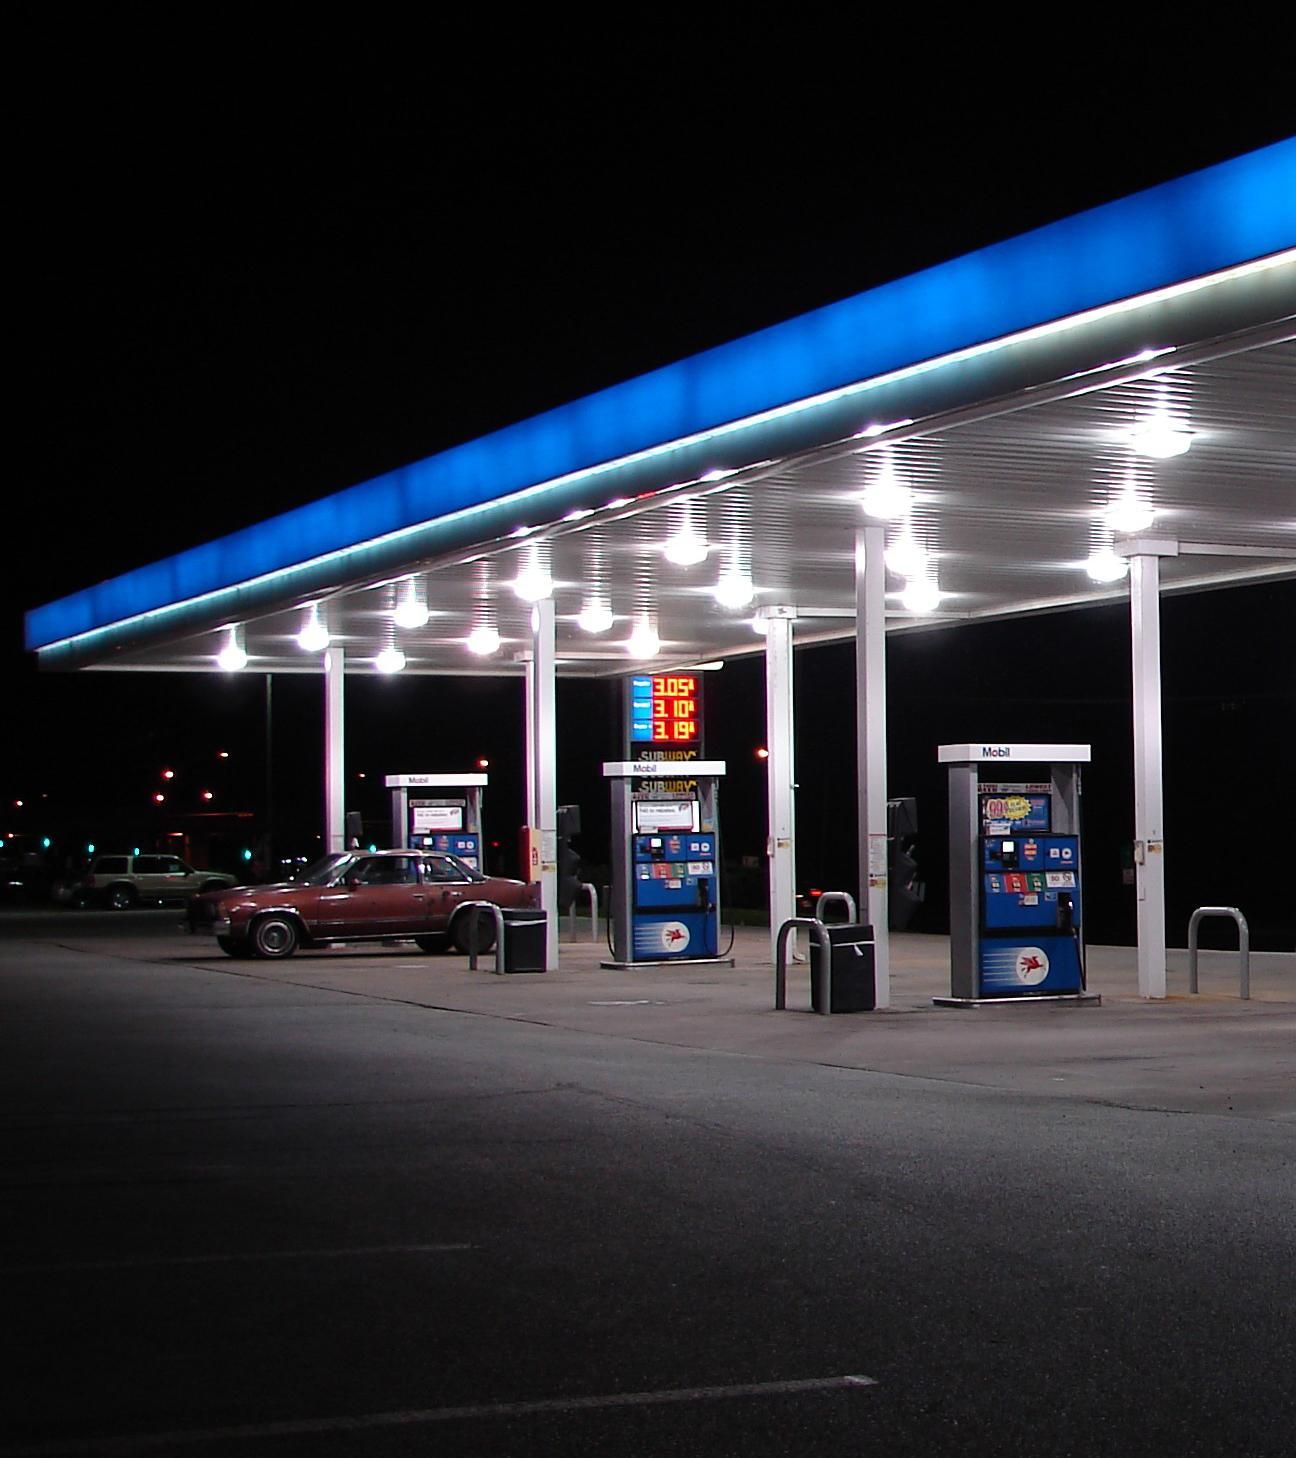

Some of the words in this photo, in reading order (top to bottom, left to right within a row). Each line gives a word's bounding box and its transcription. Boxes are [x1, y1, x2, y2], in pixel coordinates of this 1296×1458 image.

[982, 746, 1010, 758] Mobil
[633, 764, 657, 773] Mobil
[639, 780, 697, 795] SUBWAY
